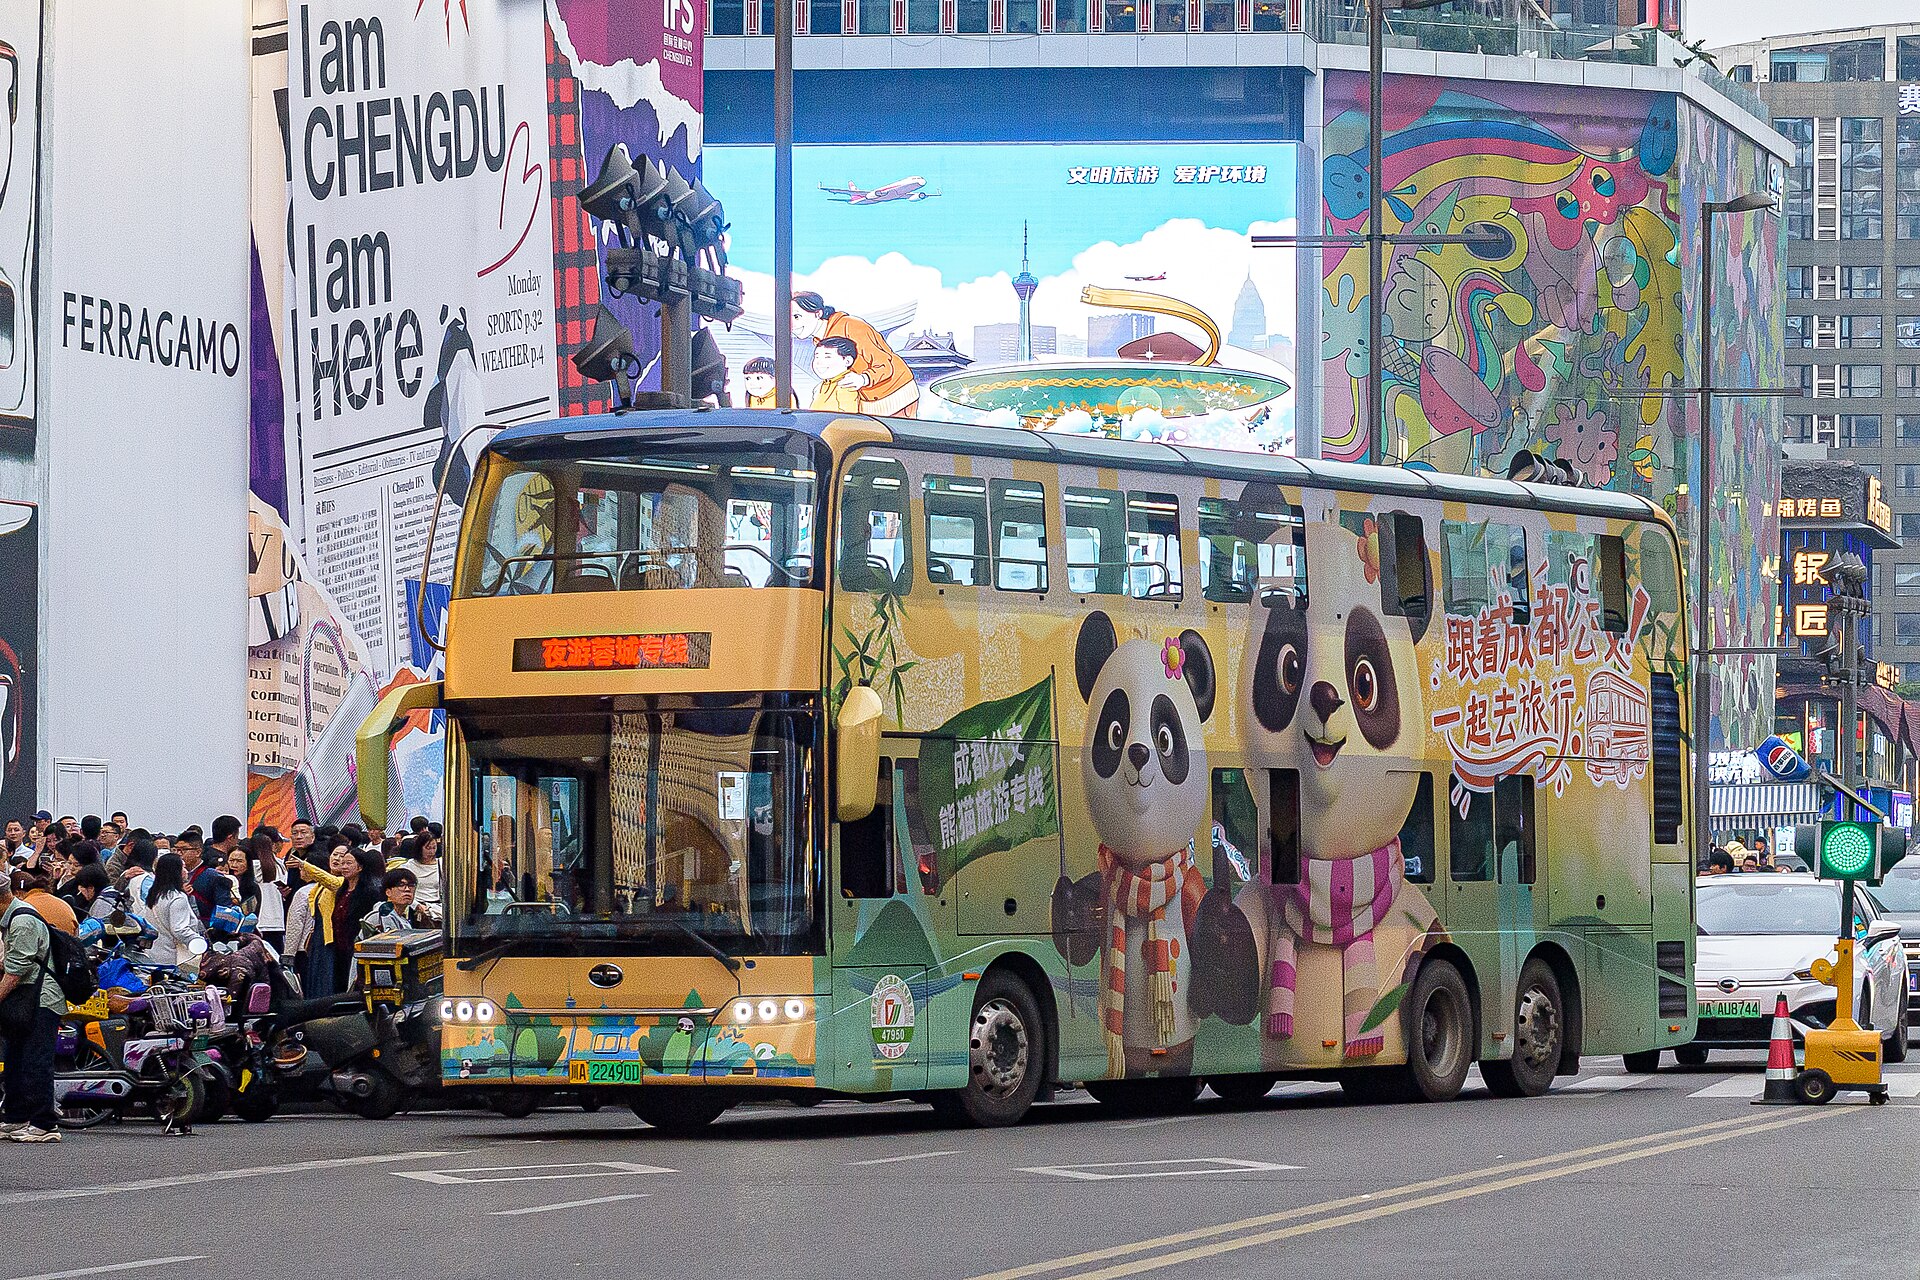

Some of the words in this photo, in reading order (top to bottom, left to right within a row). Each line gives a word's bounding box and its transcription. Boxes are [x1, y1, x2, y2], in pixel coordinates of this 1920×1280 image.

[301, 4, 312, 98] I
[319, 16, 386, 95] am
[304, 84, 506, 201] CHENGDU
[1067, 165, 1160, 185] 文明旅游
[1173, 164, 1267, 184] 爱护环境
[307, 224, 318, 318] I
[325, 230, 392, 313] am
[507, 269, 542, 297] Monday
[62, 291, 241, 378] FERRAGAMO
[487, 309, 523, 337] SPORTS
[524, 309, 543, 335] p.32
[311, 308, 424, 421] Here
[481, 343, 530, 374] WEATHER
[530, 344, 544, 369] p.4
[415, 475, 425, 489] IFS
[542, 633, 689, 668] 夜游蓉城专线
[1434, 679, 1575, 752] 一起去旅行
[954, 721, 1025, 789] 成都公交
[939, 765, 1045, 849] 熊猫旅游专线
[1717, 1002, 1759, 1015] AU8744
